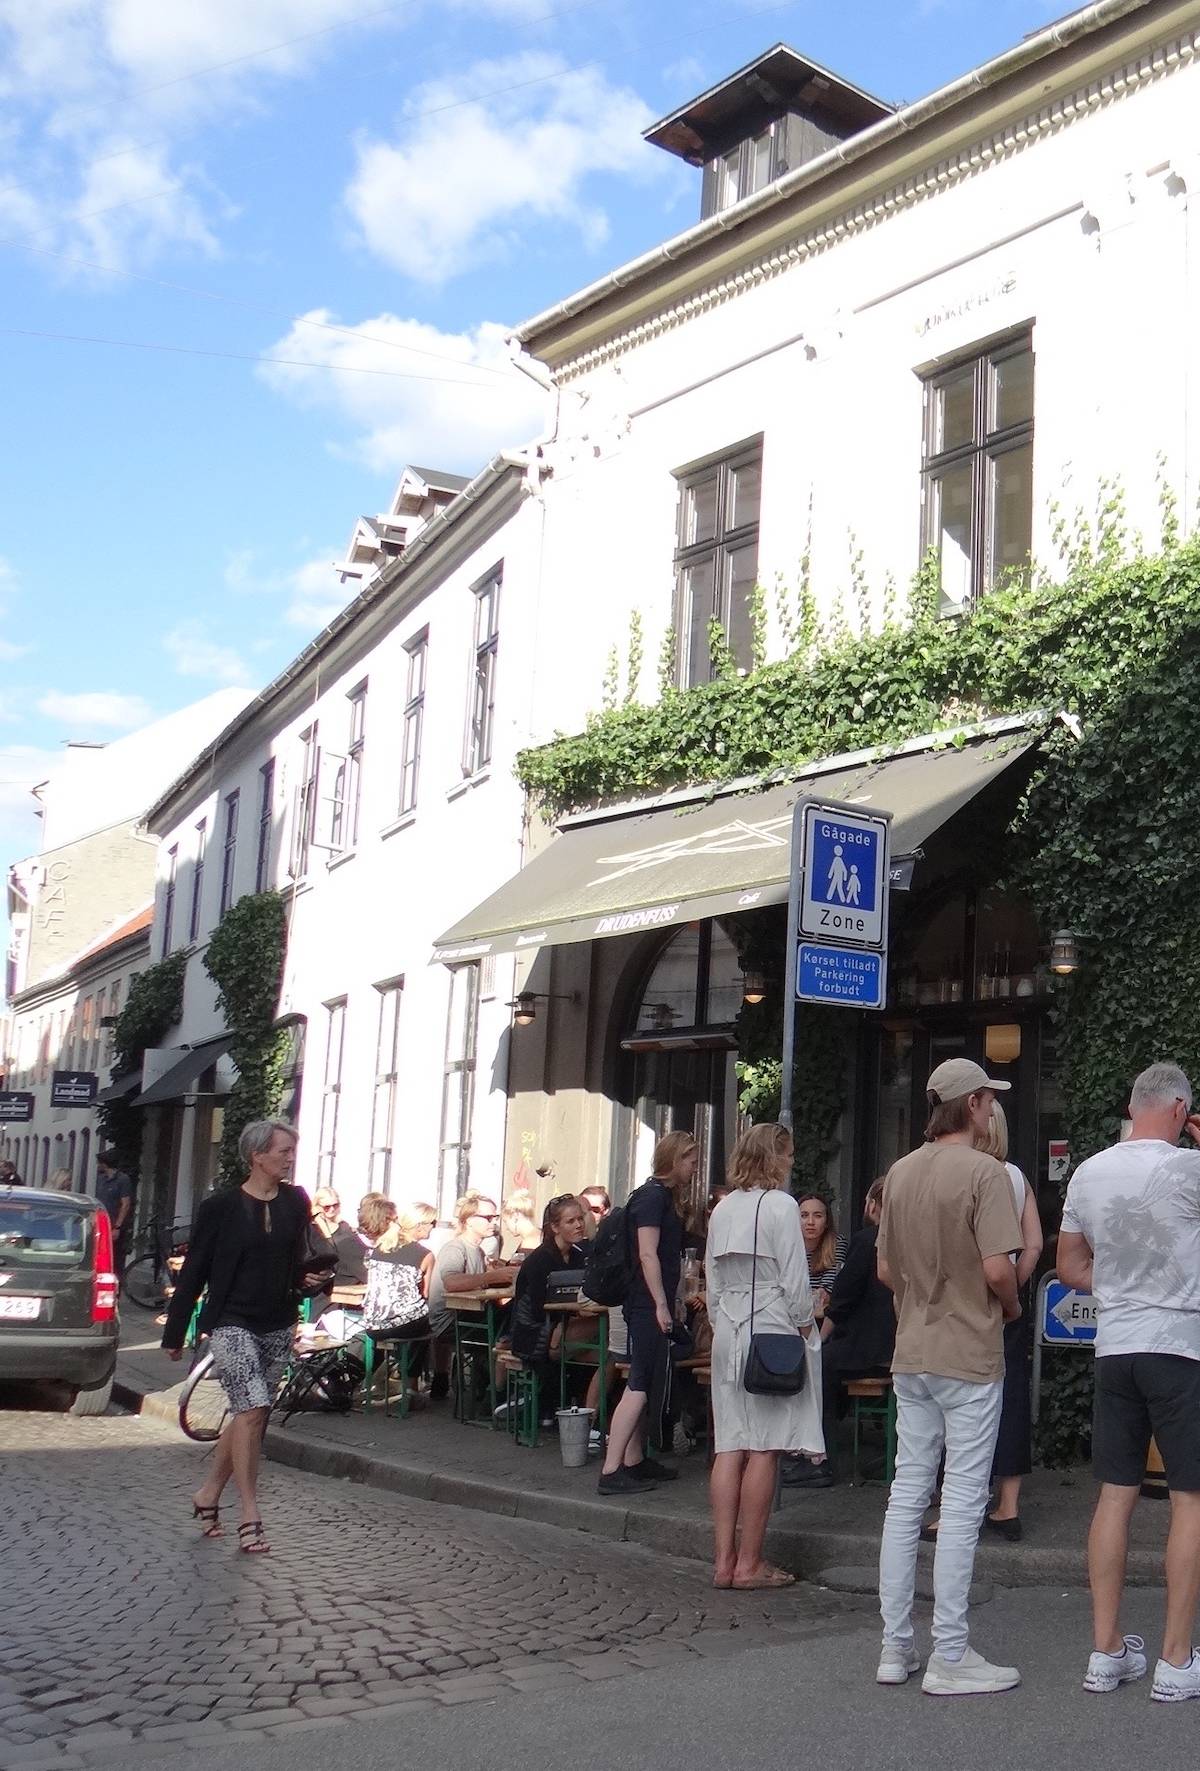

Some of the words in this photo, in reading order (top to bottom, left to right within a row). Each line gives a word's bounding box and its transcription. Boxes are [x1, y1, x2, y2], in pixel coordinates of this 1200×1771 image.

[821, 824, 871, 846] Gågade
[594, 904, 681, 934] DRUDENFUSS
[820, 909, 865, 932] Zone
[803, 952, 839, 968] Kørsel
[843, 956, 876, 972] tilladt
[814, 967, 865, 985] Parkering
[818, 980, 860, 996] forbudt
[1071, 1303, 1097, 1319] Ens
